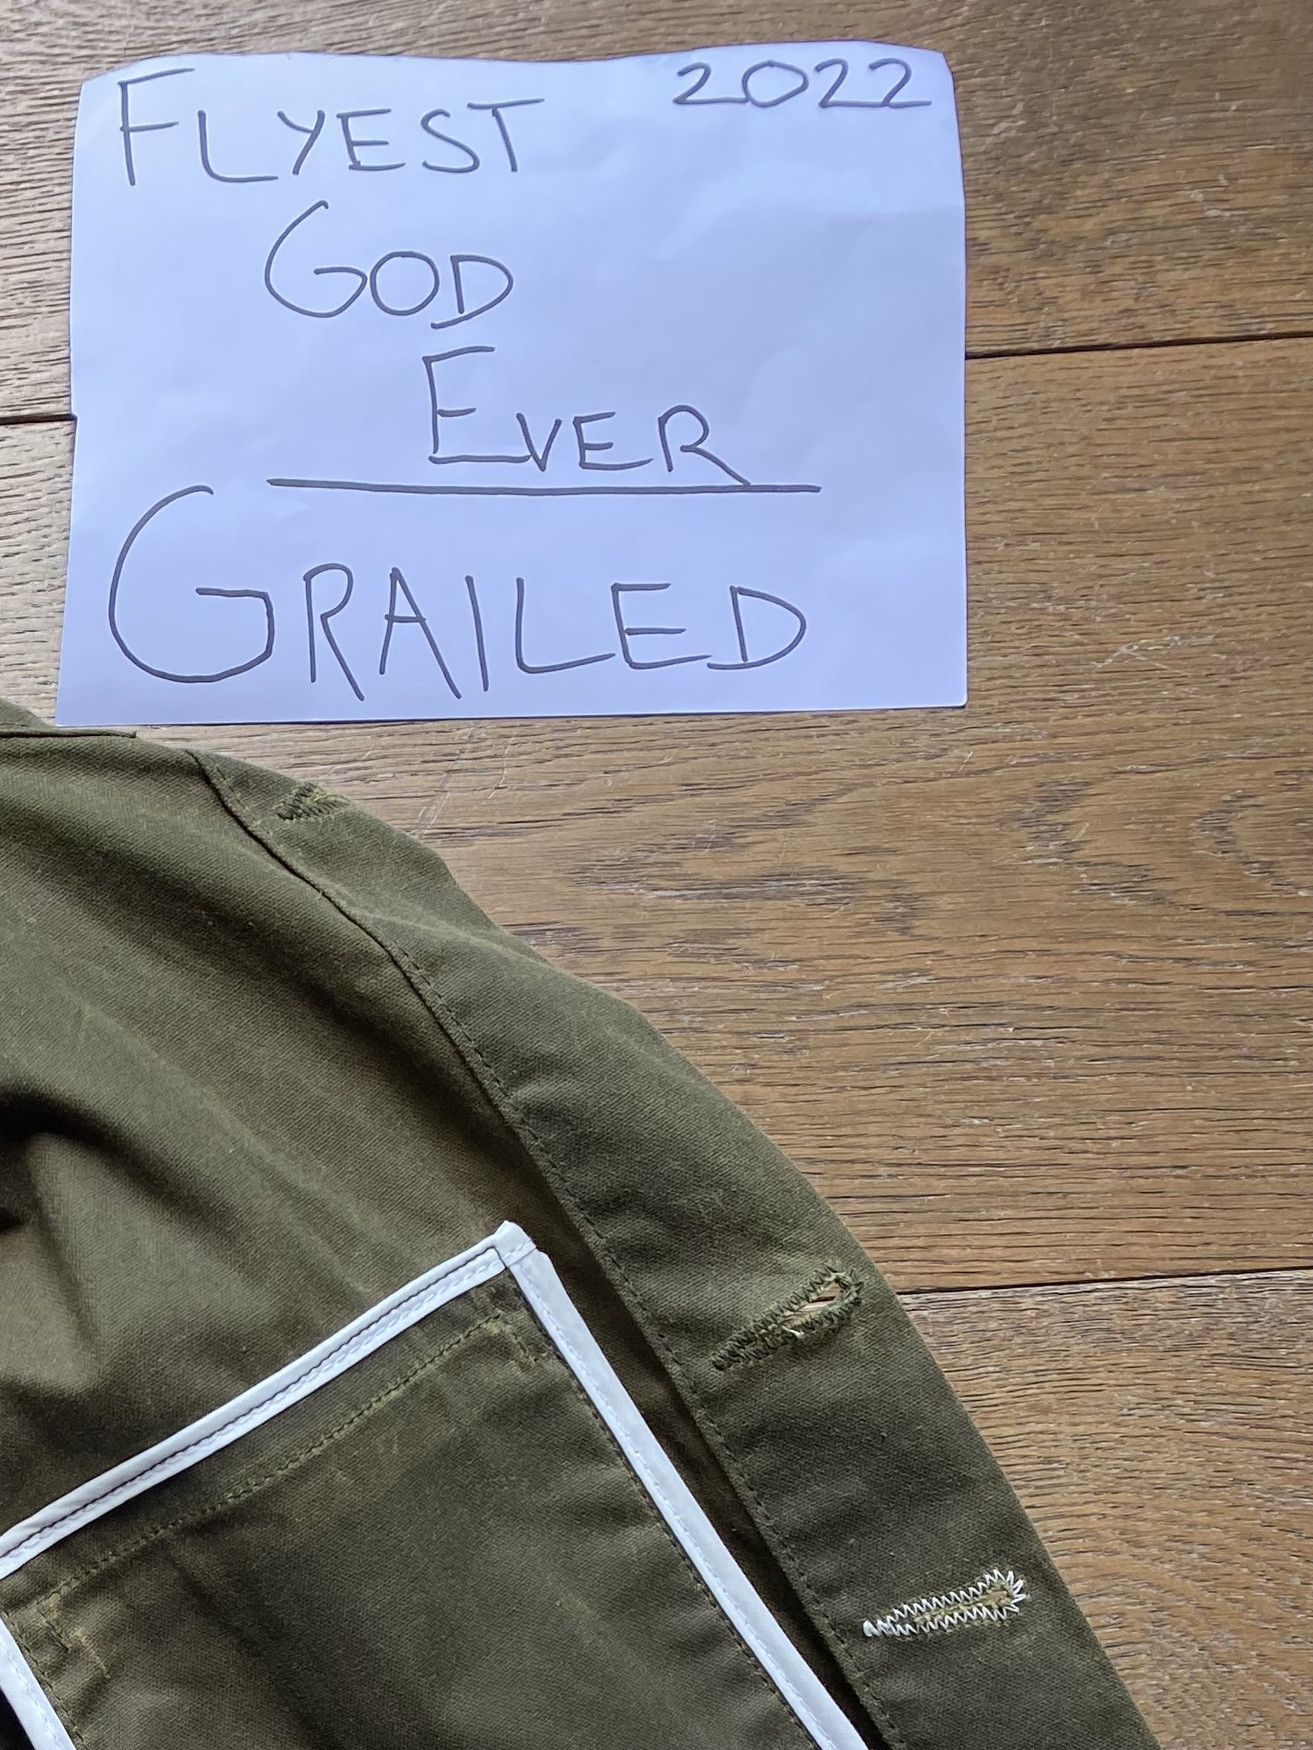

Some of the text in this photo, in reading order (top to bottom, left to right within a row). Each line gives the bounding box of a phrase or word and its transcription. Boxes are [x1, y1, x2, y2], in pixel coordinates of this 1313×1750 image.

[118, 67, 545, 186] FLYEST
[672, 59, 932, 109] 2022
[264, 200, 514, 328] GOD
[422, 346, 751, 486] EVER
[107, 485, 807, 700] GRAILED
